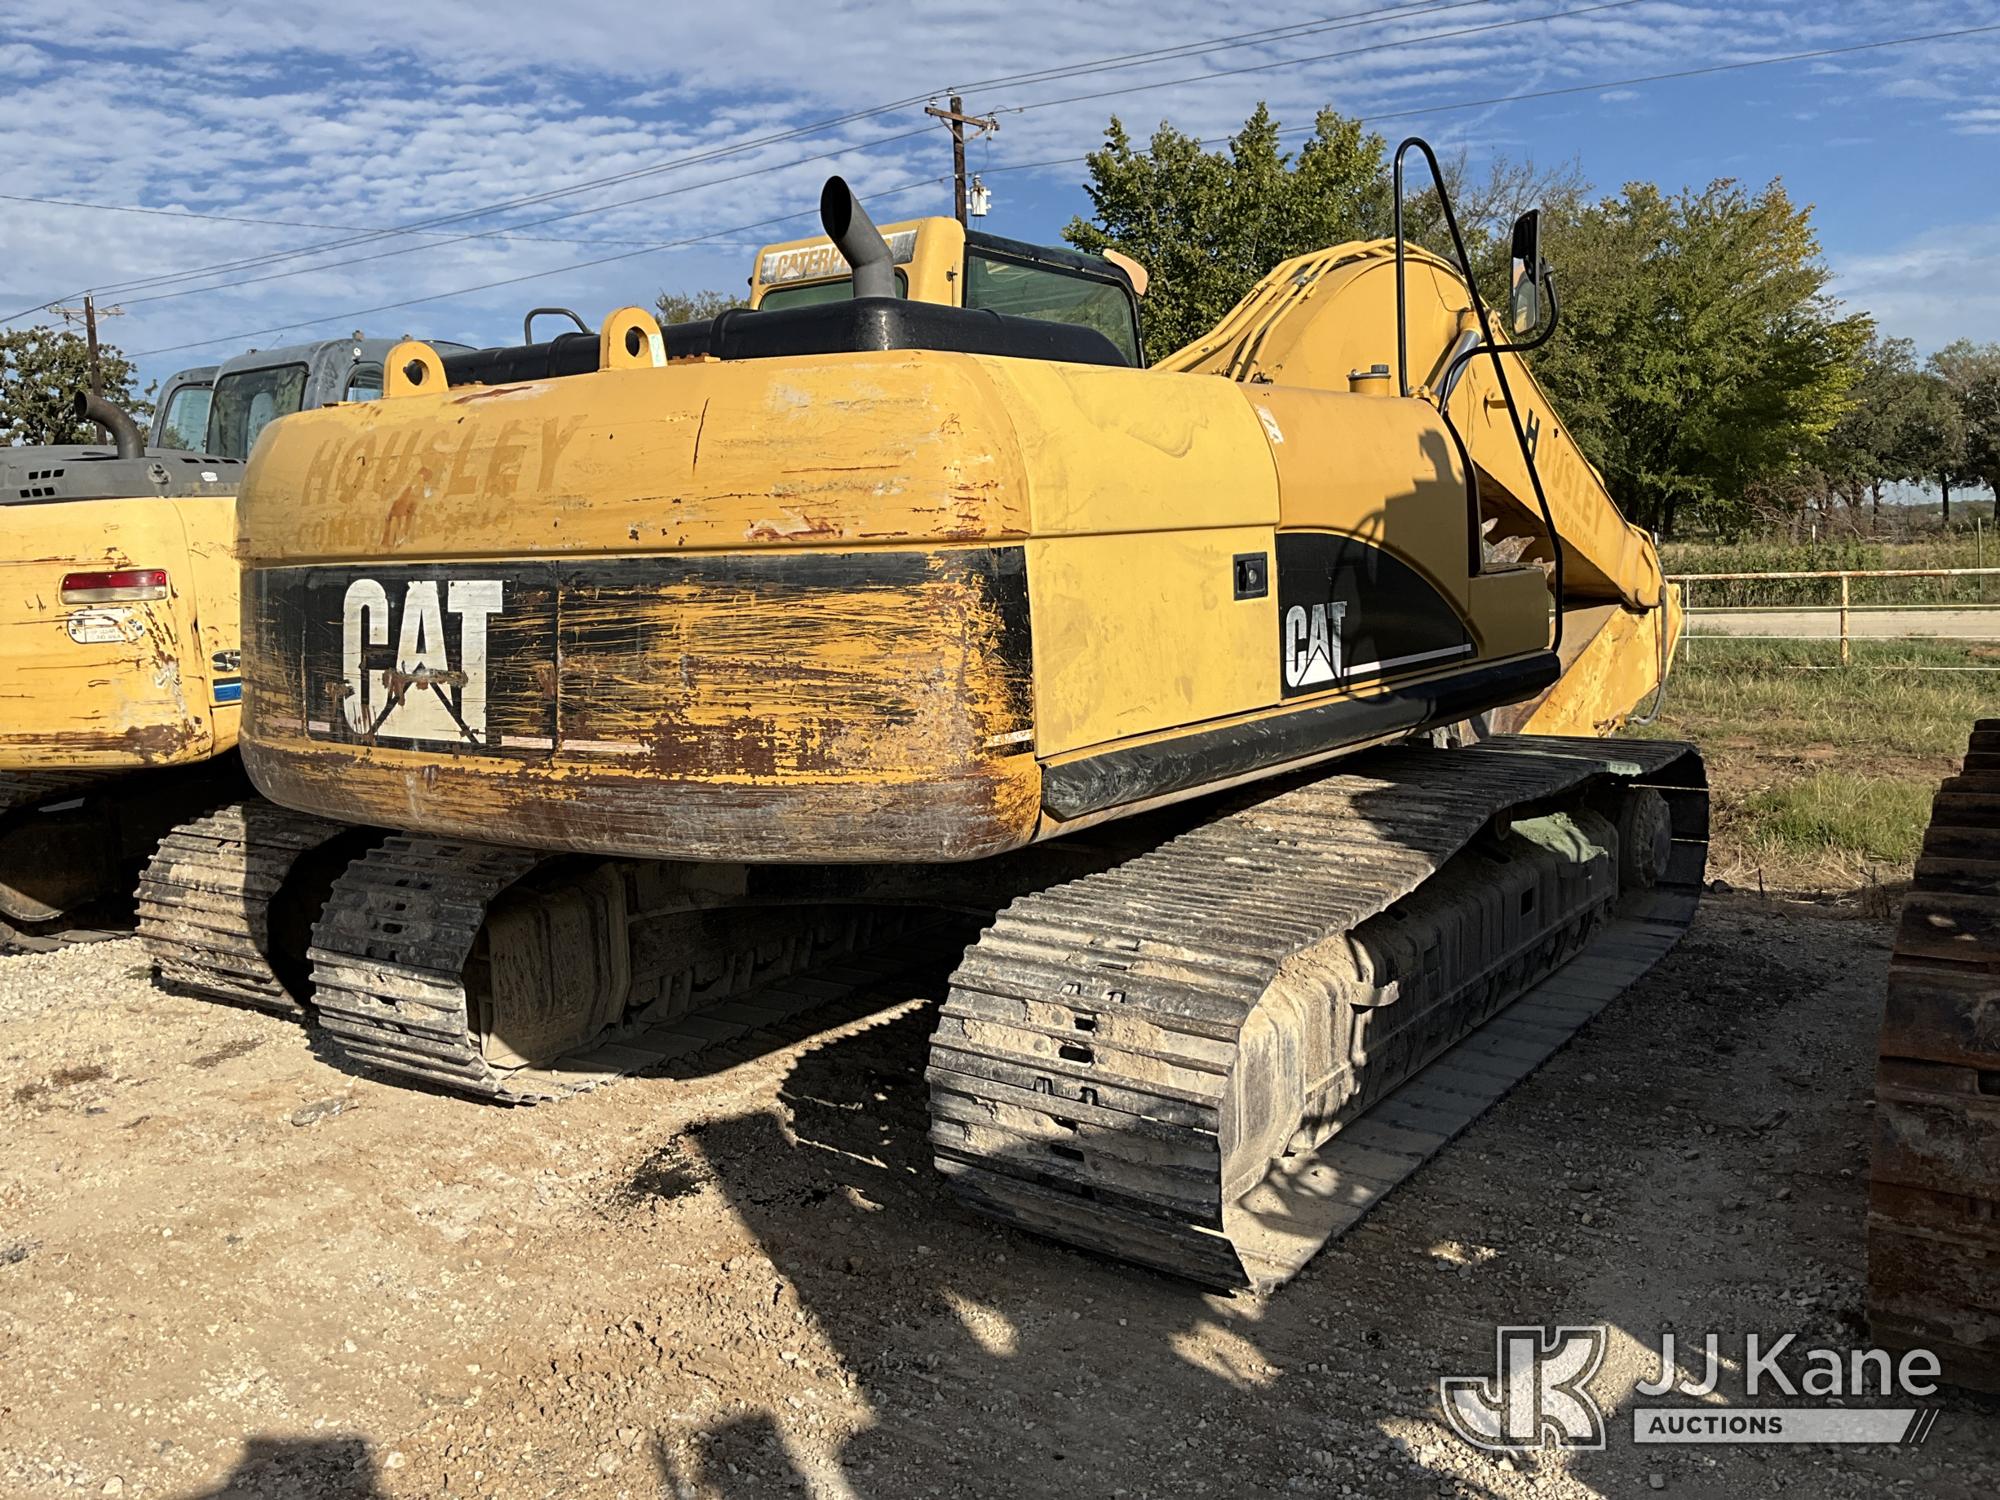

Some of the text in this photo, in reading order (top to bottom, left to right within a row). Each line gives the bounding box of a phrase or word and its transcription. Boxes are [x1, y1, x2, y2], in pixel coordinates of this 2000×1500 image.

[301, 413, 588, 505] HOUSLEY
[343, 578, 503, 744] CAT
[1286, 601, 1347, 688] CAT
